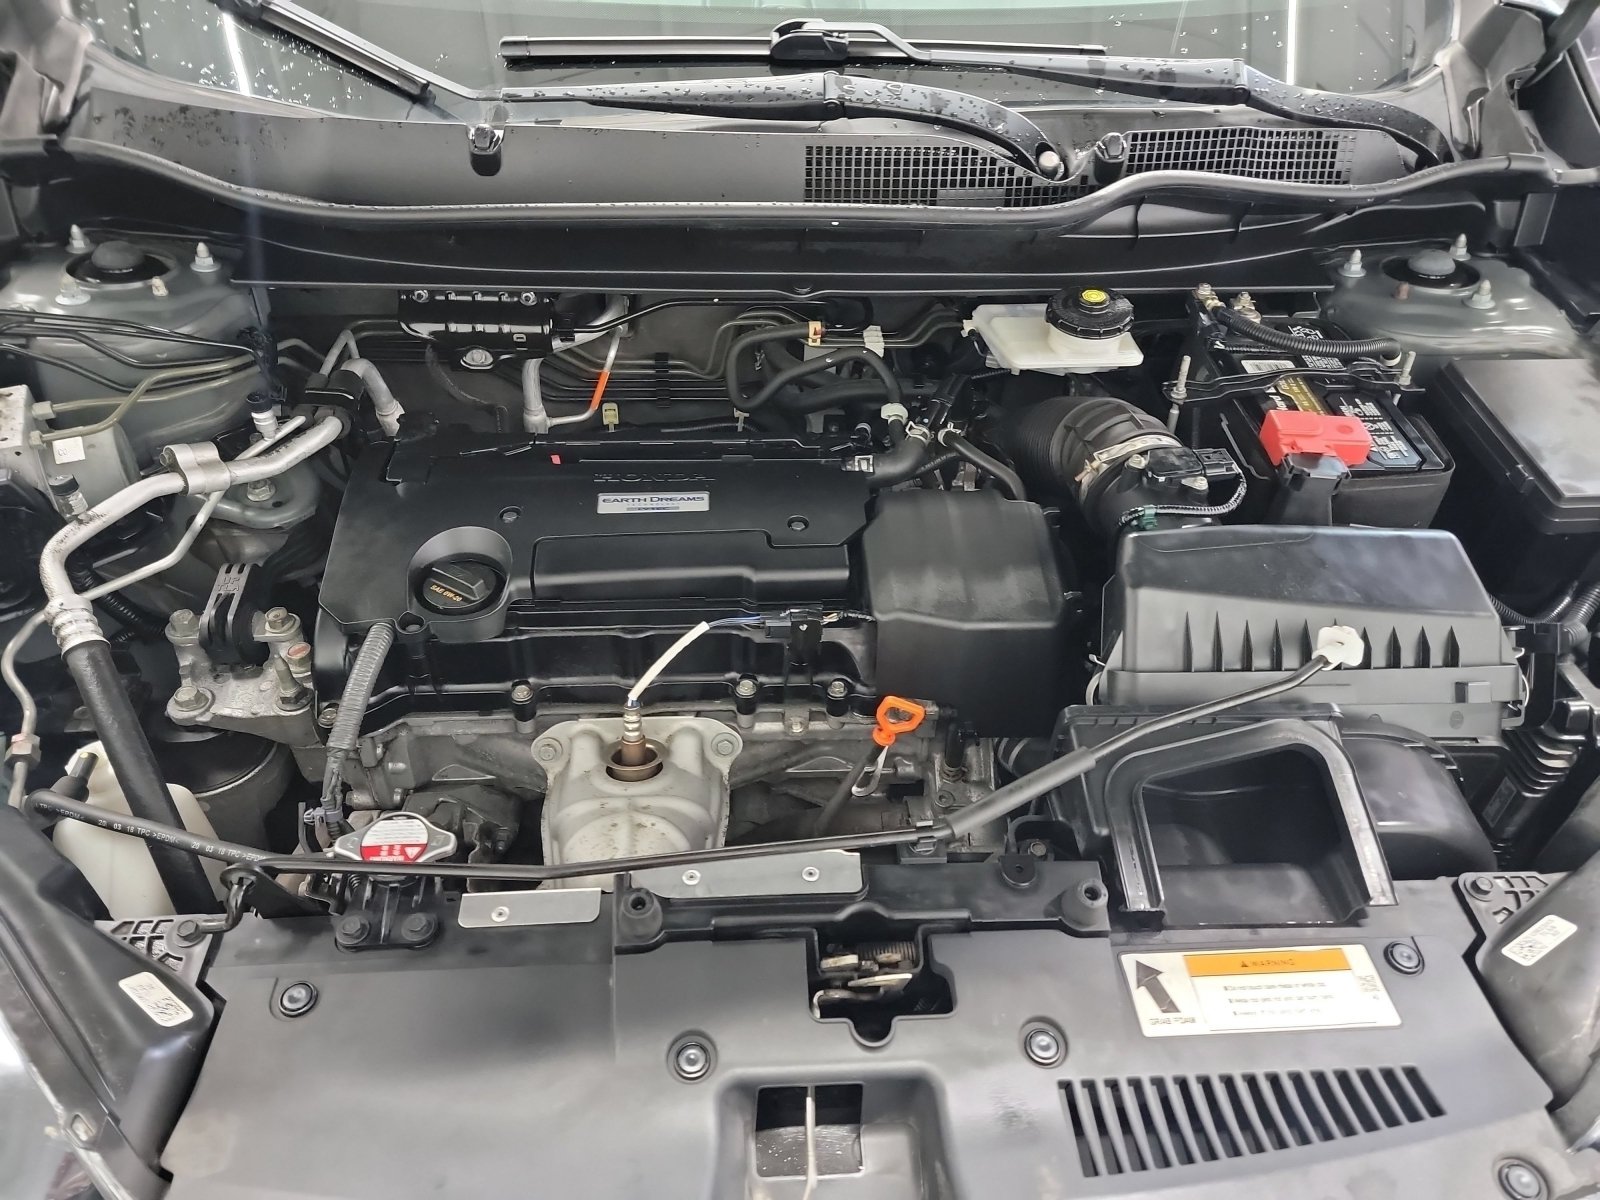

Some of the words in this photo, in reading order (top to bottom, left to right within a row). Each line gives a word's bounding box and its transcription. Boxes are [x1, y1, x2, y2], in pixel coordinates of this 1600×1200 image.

[593, 473, 717, 482] HONDA
[430, 584, 446, 594] SAE
[137, 827, 151, 836] TPC
[227, 849, 241, 858] TPC
